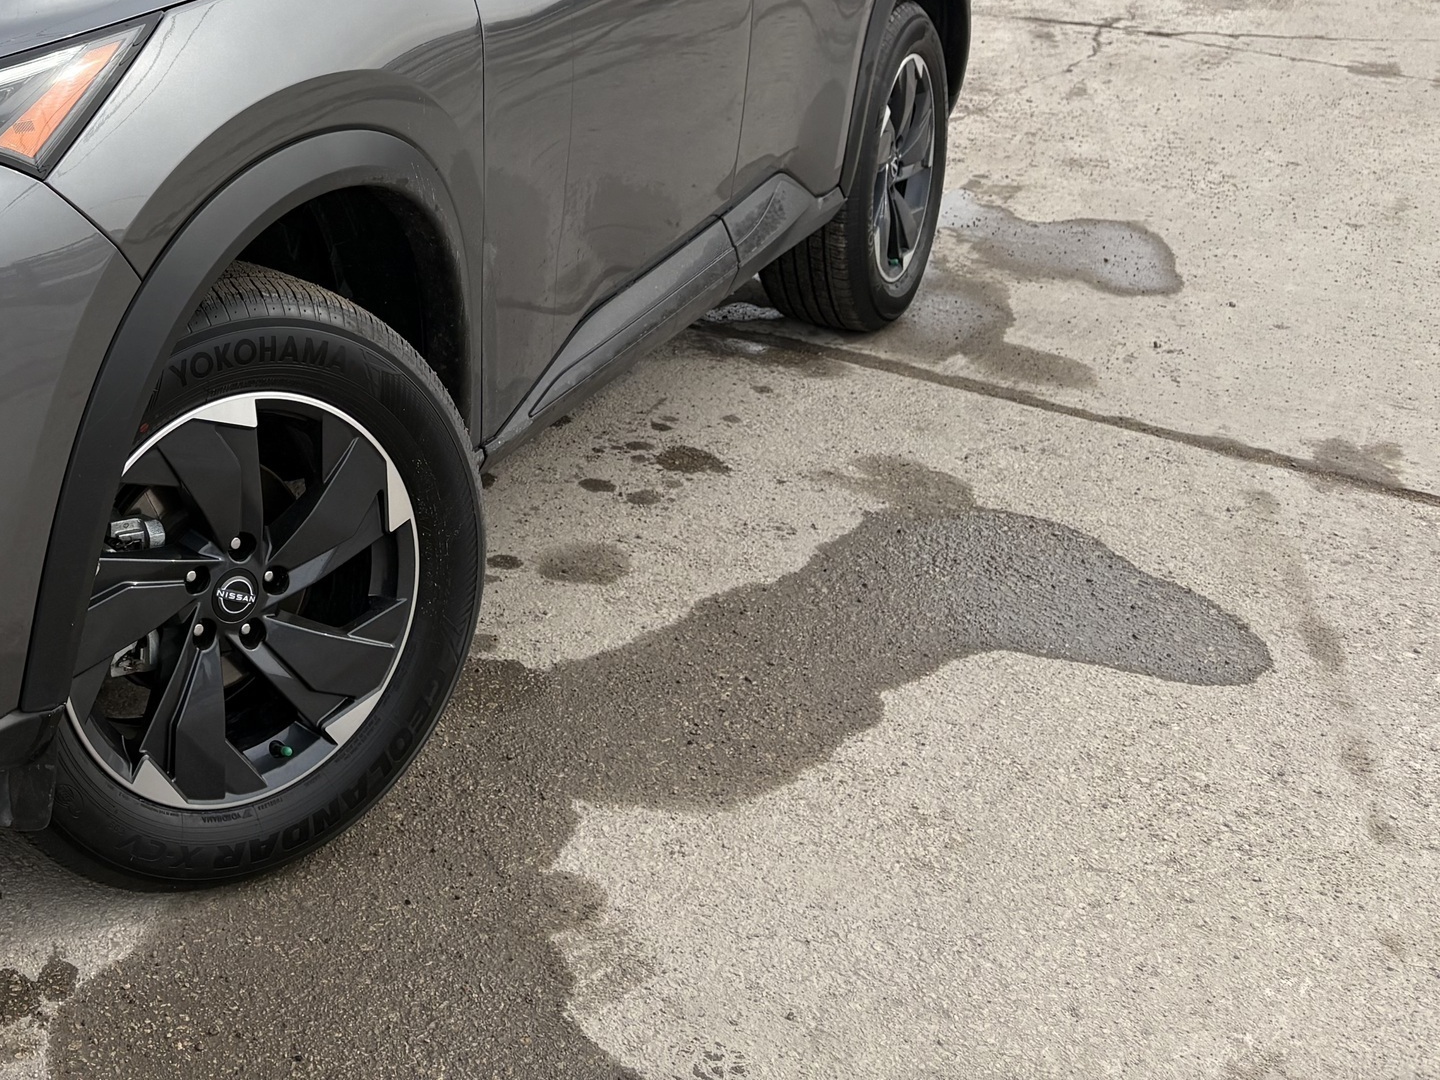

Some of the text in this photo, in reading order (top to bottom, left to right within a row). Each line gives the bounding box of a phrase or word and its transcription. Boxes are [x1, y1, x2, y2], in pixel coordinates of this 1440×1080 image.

[170, 335, 348, 388] YOKOHAMA
[216, 589, 257, 604] NISSAN
[213, 678, 442, 870] GEOLANDAR
